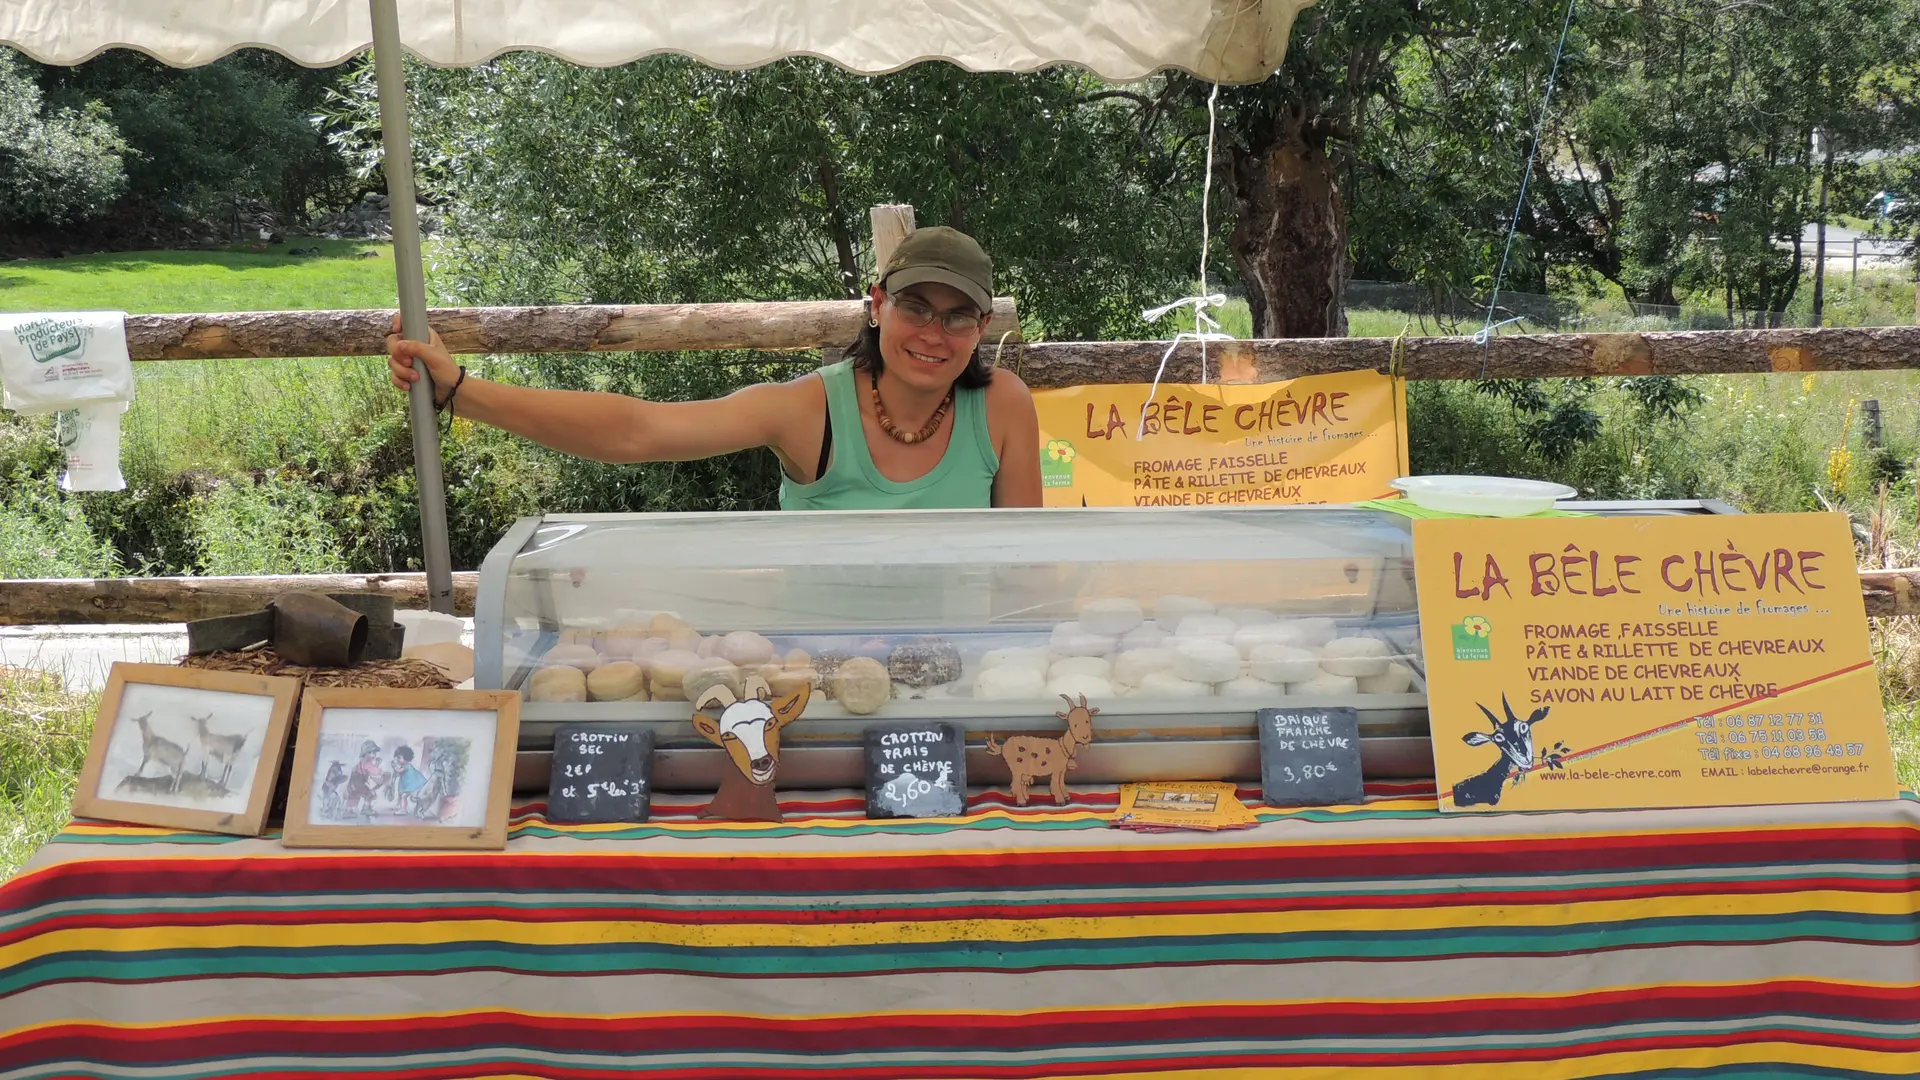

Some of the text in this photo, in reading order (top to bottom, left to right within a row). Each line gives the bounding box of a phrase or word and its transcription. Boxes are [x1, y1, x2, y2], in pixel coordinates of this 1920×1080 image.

[35, 340, 49, 351] de
[49, 329, 75, 345] Pays
[1086, 390, 1349, 440] LA BÊLE CHÈVRE
[1245, 436, 1263, 447] Une
[1269, 434, 1302, 446] histoire
[1308, 431, 1318, 441] de
[1323, 428, 1363, 440] fromages
[1134, 458, 1202, 474] FROMAGE
[1134, 462, 1366, 490] PÂTE & RILLETTE DE CHEVREAUX
[1134, 493, 1190, 507] VIANDE
[1196, 491, 1214, 505] DE
[1218, 485, 1302, 503] CHEVREAUX
[1453, 539, 1826, 601] LA BÊLE CHÈVRE
[1659, 604, 1682, 617] Une
[1686, 602, 1731, 617] histoire
[1737, 602, 1751, 614] de
[1756, 600, 1809, 617] fromages
[1524, 623, 1610, 639] FROMAGE
[1526, 639, 1825, 659] PÂTE & RILLETTE DE CHEVREAUX
[1527, 663, 1741, 681] VIANDE DE CHEVREAUX
[1530, 677, 1778, 703] SAVON AU LAIT DE CHÈVRE
[1694, 715, 1715, 728] Tél
[1725, 715, 1744, 728] 06
[1747, 714, 1765, 727] 87
[1768, 714, 1783, 726] 12
[1786, 713, 1804, 725] 77
[1808, 712, 1824, 725] 31
[881, 731, 943, 745] CROTTIN
[1280, 737, 1349, 751] DE CHÈVRE
[1696, 731, 1718, 744] Tél
[1728, 731, 1747, 744] 06
[1750, 730, 1768, 743] 75
[1771, 730, 1784, 743] 11
[1787, 729, 1805, 742] 03
[1808, 728, 1827, 742] 58
[579, 744, 604, 755] SEC
[1698, 747, 1721, 761] Tél
[1724, 747, 1751, 760] fixe
[1761, 746, 1780, 759] 04
[1784, 745, 1801, 758] 68
[1804, 745, 1823, 758] 96
[1826, 744, 1844, 757] 48
[1846, 743, 1864, 756] 57
[881, 760, 953, 774] DE CHÈVRE
[1284, 761, 1338, 784] 3,80€
[1540, 768, 1682, 781] www.la-bele-chevre.com
[1701, 767, 1738, 778] EMAIL
[1747, 762, 1870, 777] labelechevre@orange.fr
[562, 785, 576, 798] et
